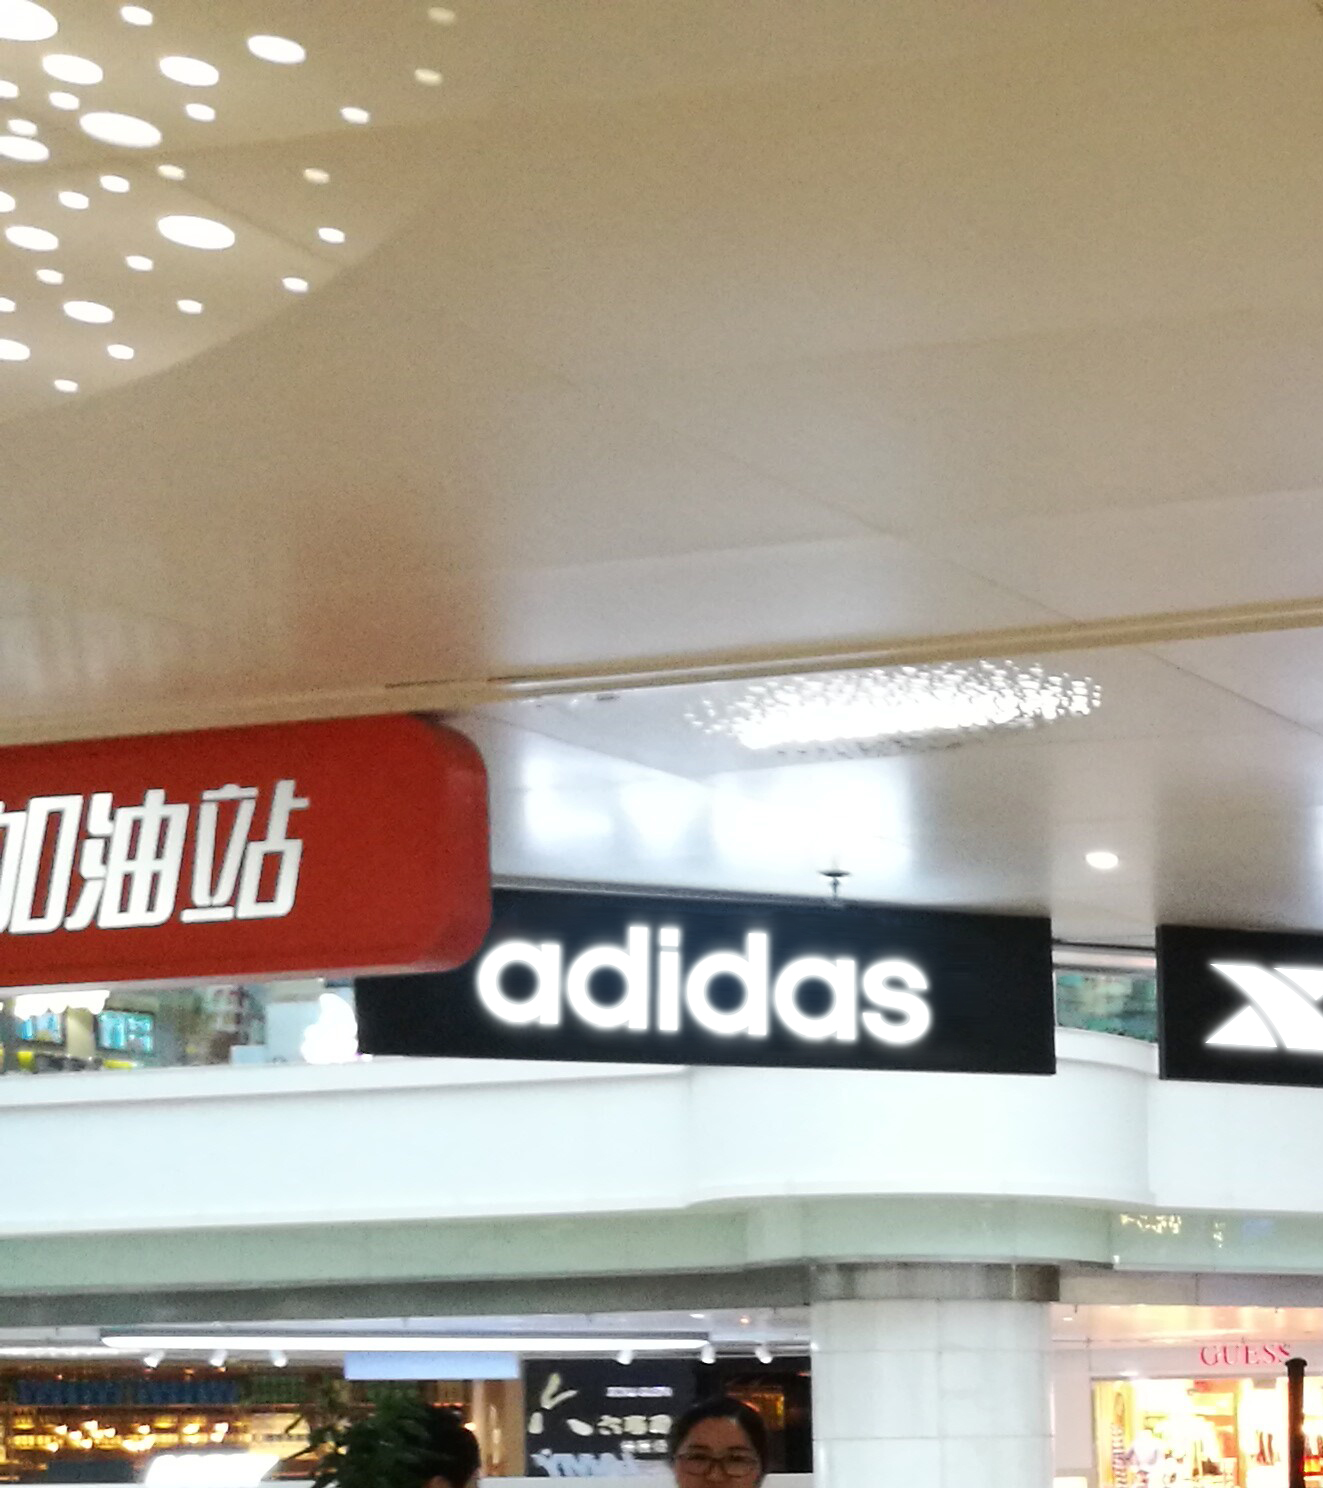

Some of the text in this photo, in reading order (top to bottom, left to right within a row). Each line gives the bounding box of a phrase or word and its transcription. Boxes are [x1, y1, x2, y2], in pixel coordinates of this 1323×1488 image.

[0, 778, 310, 935] 加油站
[476, 924, 932, 1046] adidas
[1200, 1344, 1290, 1366] GUESS
